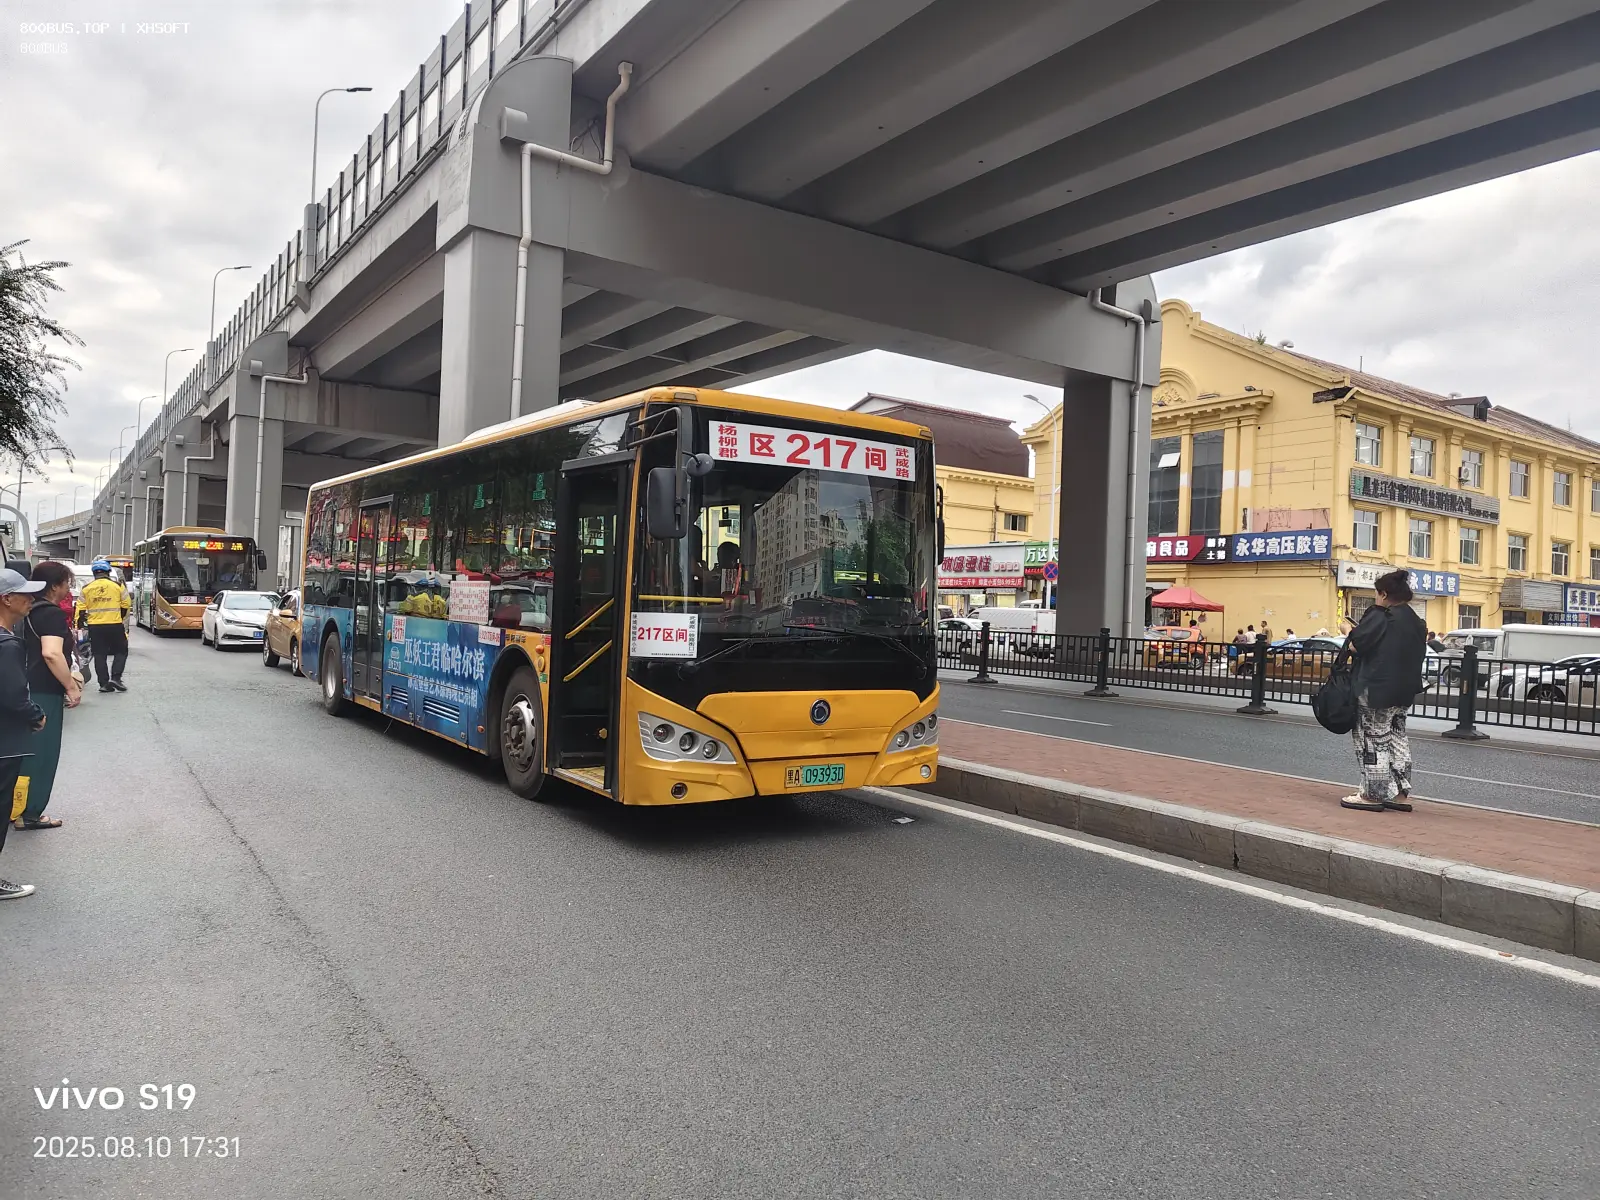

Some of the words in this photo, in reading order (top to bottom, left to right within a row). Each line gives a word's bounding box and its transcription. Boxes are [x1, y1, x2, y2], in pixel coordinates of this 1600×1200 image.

[718, 424, 738, 459] 杨柳郡
[786, 433, 857, 470] 217
[895, 447, 909, 479] 武威路
[1236, 535, 1328, 557] 永华高压胶管
[637, 627, 688, 643] 217区间
